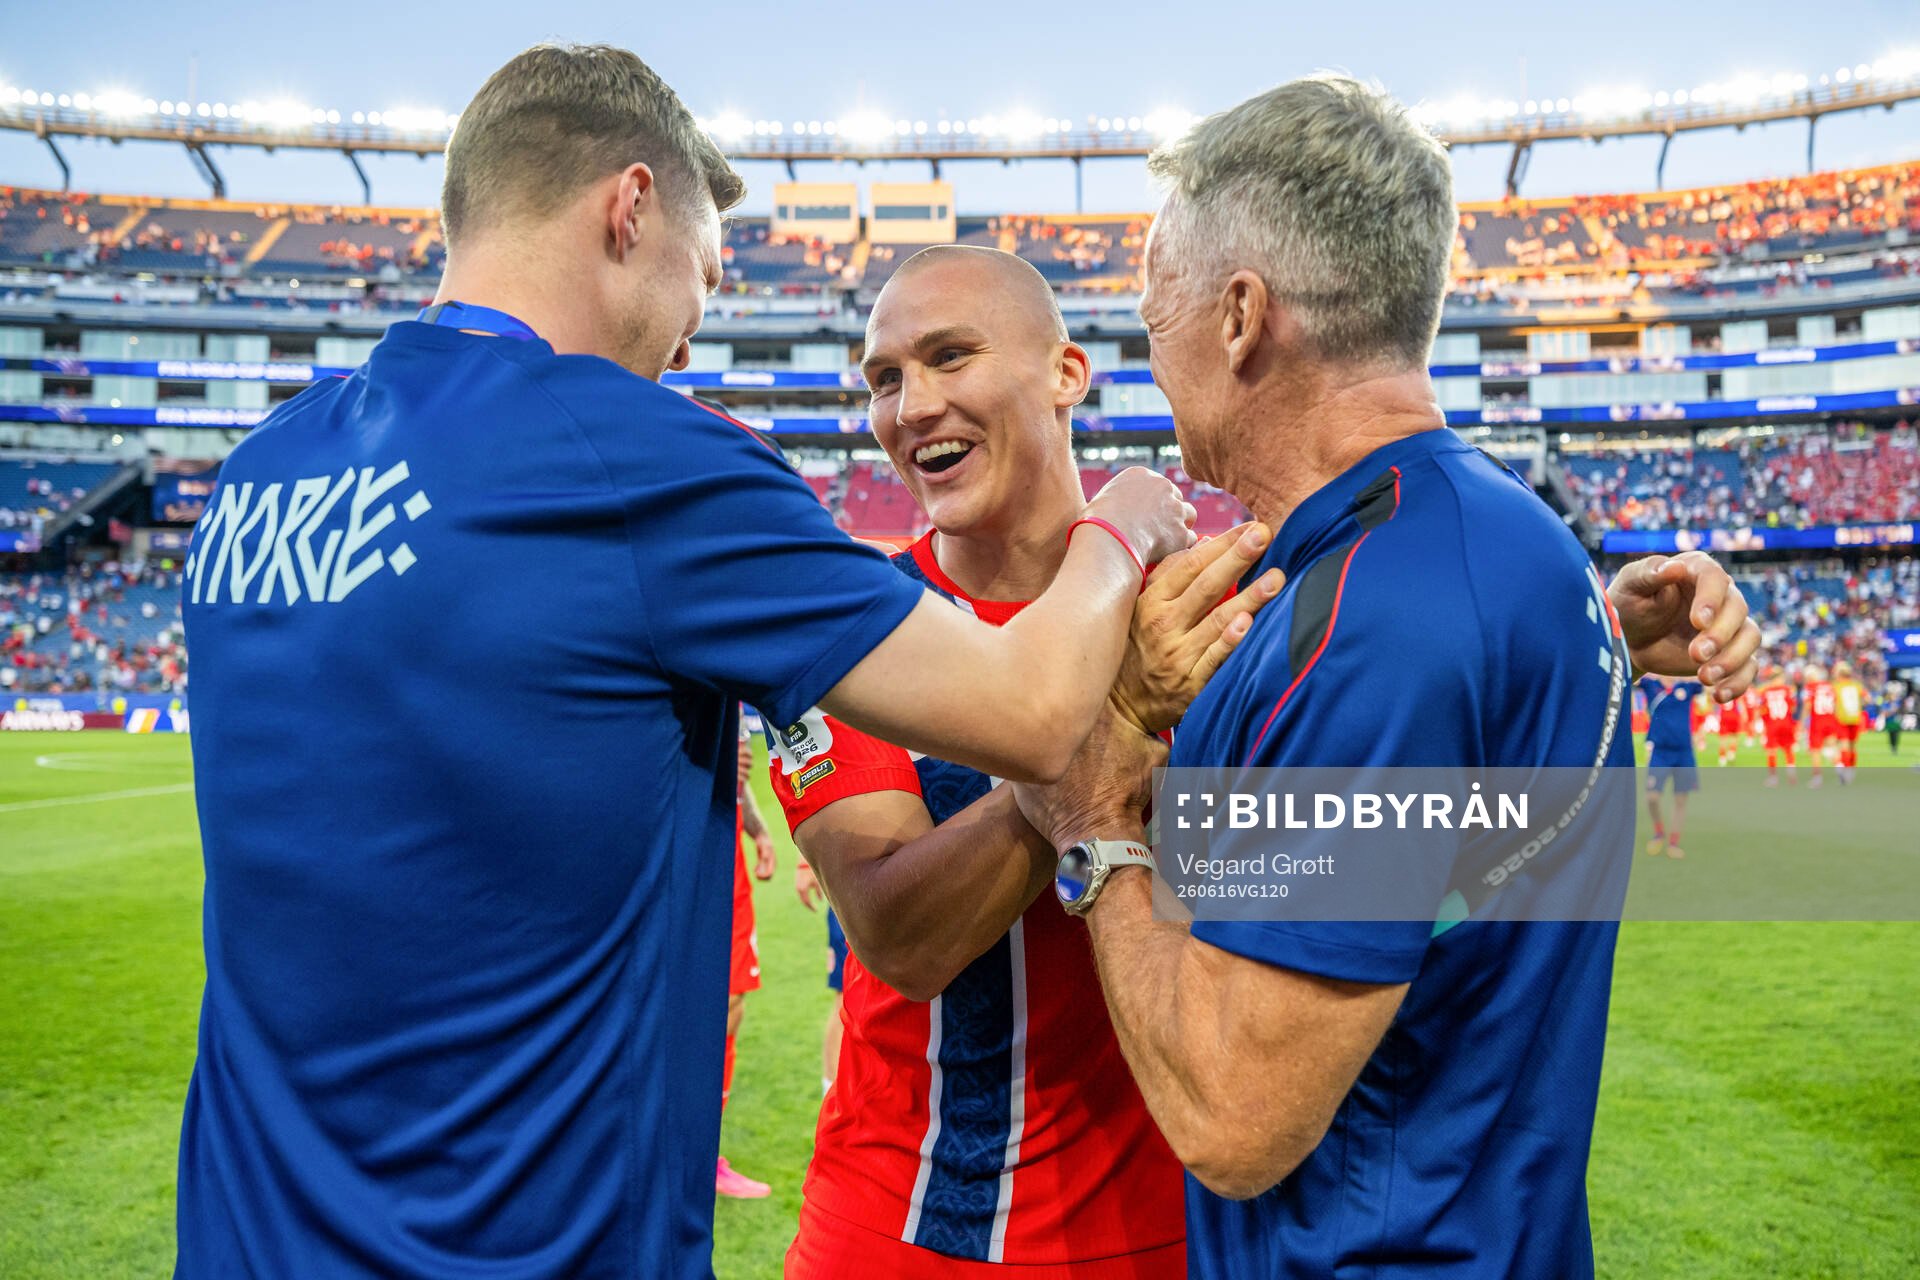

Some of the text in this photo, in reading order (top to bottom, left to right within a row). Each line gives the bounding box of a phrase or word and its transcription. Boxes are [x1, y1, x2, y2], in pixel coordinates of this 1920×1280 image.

[1609, 655, 1624, 703] FIFA
[791, 731, 804, 743] FIFA
[1588, 706, 1619, 787] WORLD
[801, 761, 829, 782] DEBUT
[1556, 786, 1590, 830] CUP
